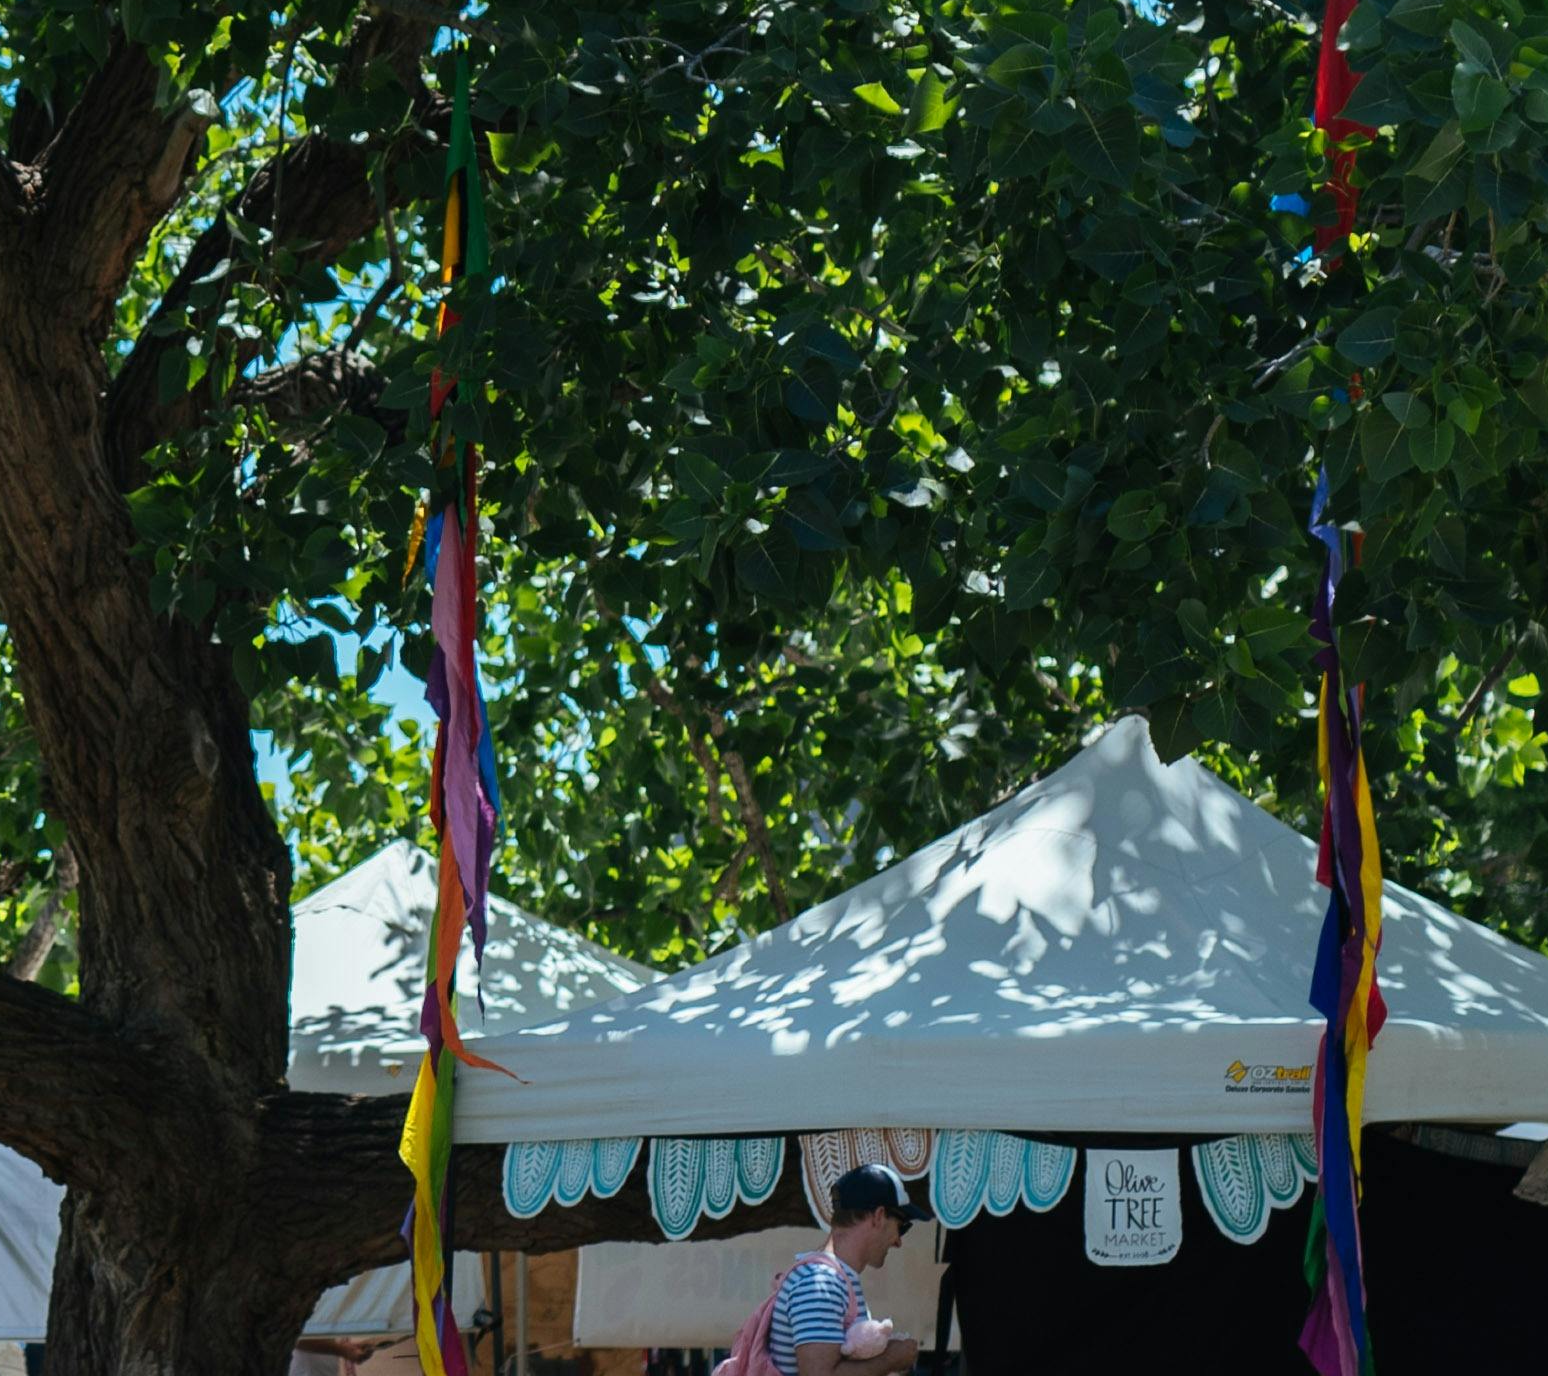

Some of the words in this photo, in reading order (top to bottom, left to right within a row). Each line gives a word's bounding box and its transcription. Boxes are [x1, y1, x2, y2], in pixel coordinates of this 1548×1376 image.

[1105, 1159, 1165, 1196] Olive
[1104, 1197, 1164, 1230] TREE
[1105, 1232, 1166, 1247] MARKET
